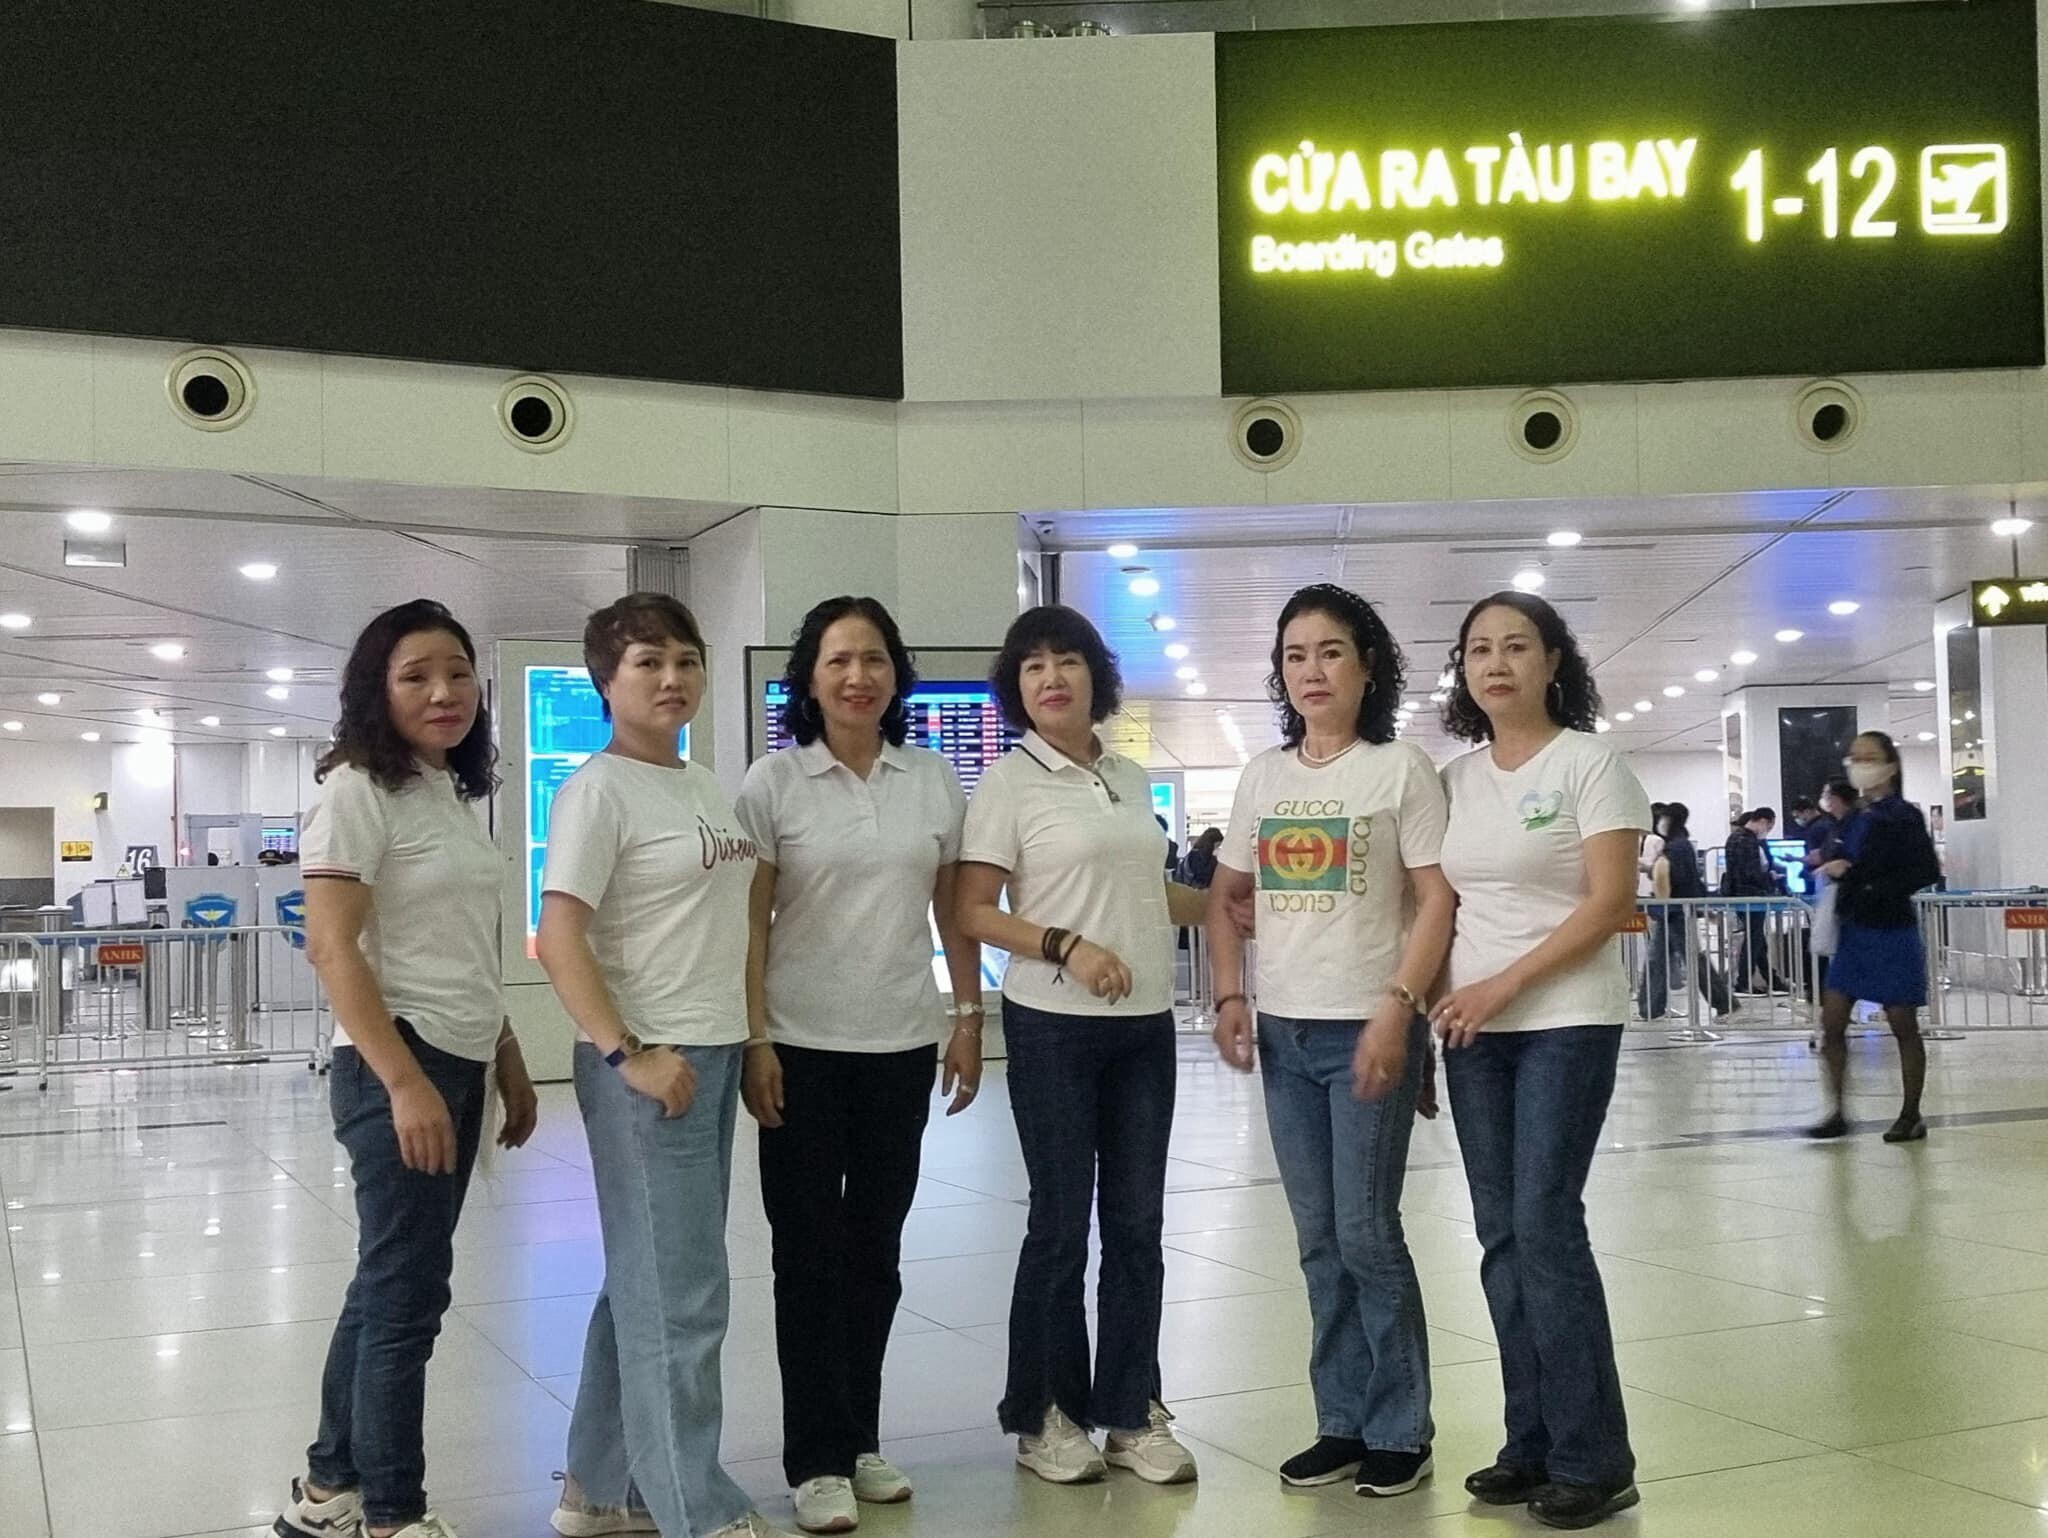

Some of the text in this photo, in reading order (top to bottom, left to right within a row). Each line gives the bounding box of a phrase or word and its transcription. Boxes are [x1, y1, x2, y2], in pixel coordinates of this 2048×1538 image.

[1251, 131, 1698, 214] CỬA RA TÀU BAY
[1729, 145, 1898, 242] 1-12
[1251, 230, 1505, 278] Boarding Gates
[1273, 799, 1345, 817] GUCCI
[1350, 815, 1374, 897] GUCCI
[1267, 892, 1337, 913] GUCCI
[101, 949, 142, 961] ANHK
